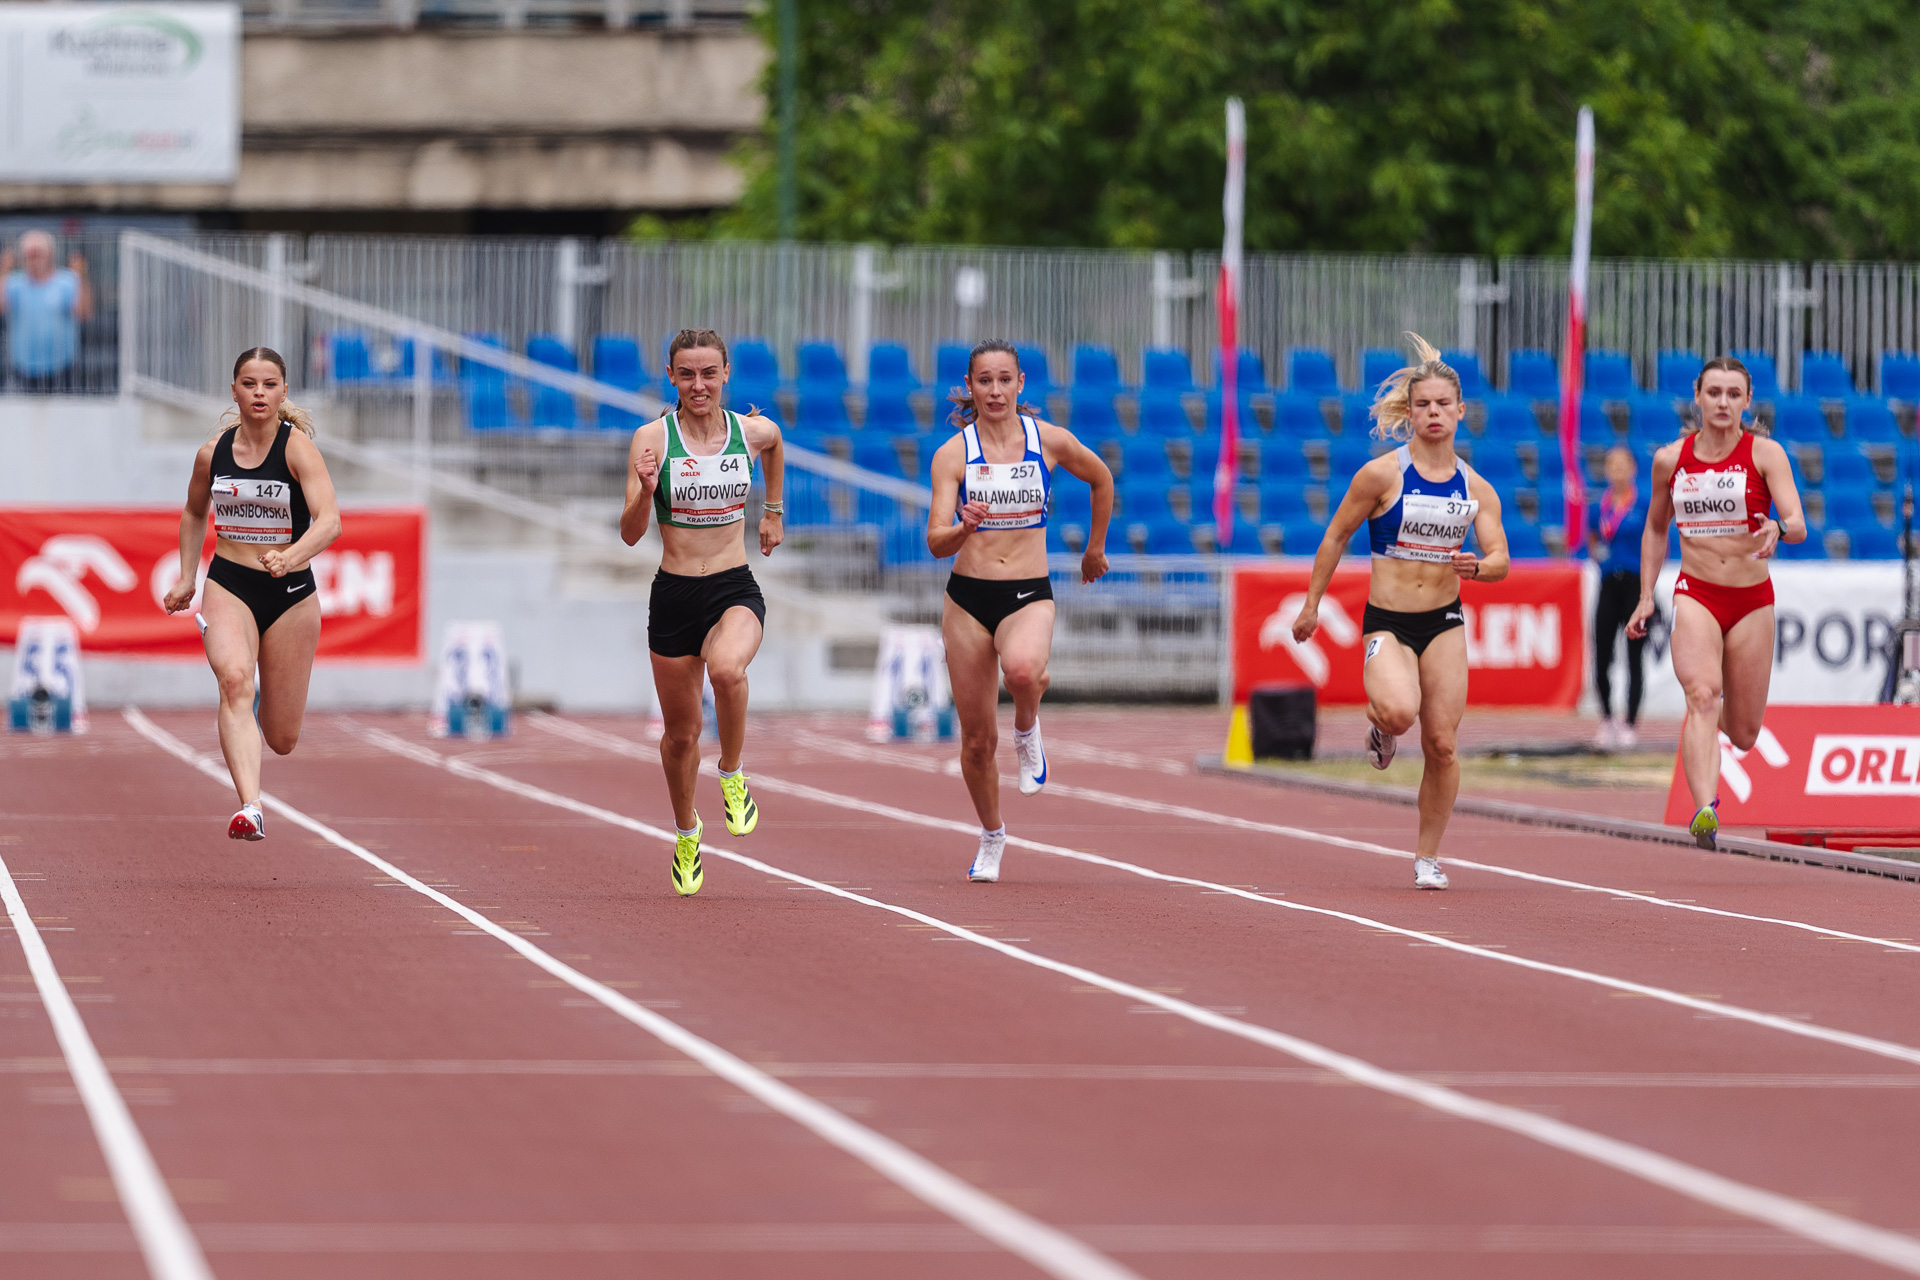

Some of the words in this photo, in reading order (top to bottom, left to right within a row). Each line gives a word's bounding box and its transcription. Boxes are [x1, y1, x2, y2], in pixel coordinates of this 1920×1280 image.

[720, 458, 739, 472] 64
[1010, 465, 1035, 479] 257
[1717, 476, 1735, 489] 66
[255, 484, 283, 498] 147
[674, 483, 748, 501] WÓJTOWICZ
[969, 489, 1042, 505] BALAWAJDER
[215, 503, 290, 520] KWASIBORSKA
[1446, 502, 1471, 516] 377
[1683, 497, 1736, 514] BEŃKO
[720, 514, 735, 522] 2025
[983, 519, 1013, 527] KRAKÓW
[1410, 551, 1440, 560] KRAKÓW
[150, 548, 395, 618] OEN
[1463, 603, 1563, 669] LEN
[1821, 747, 1920, 784] ORL
